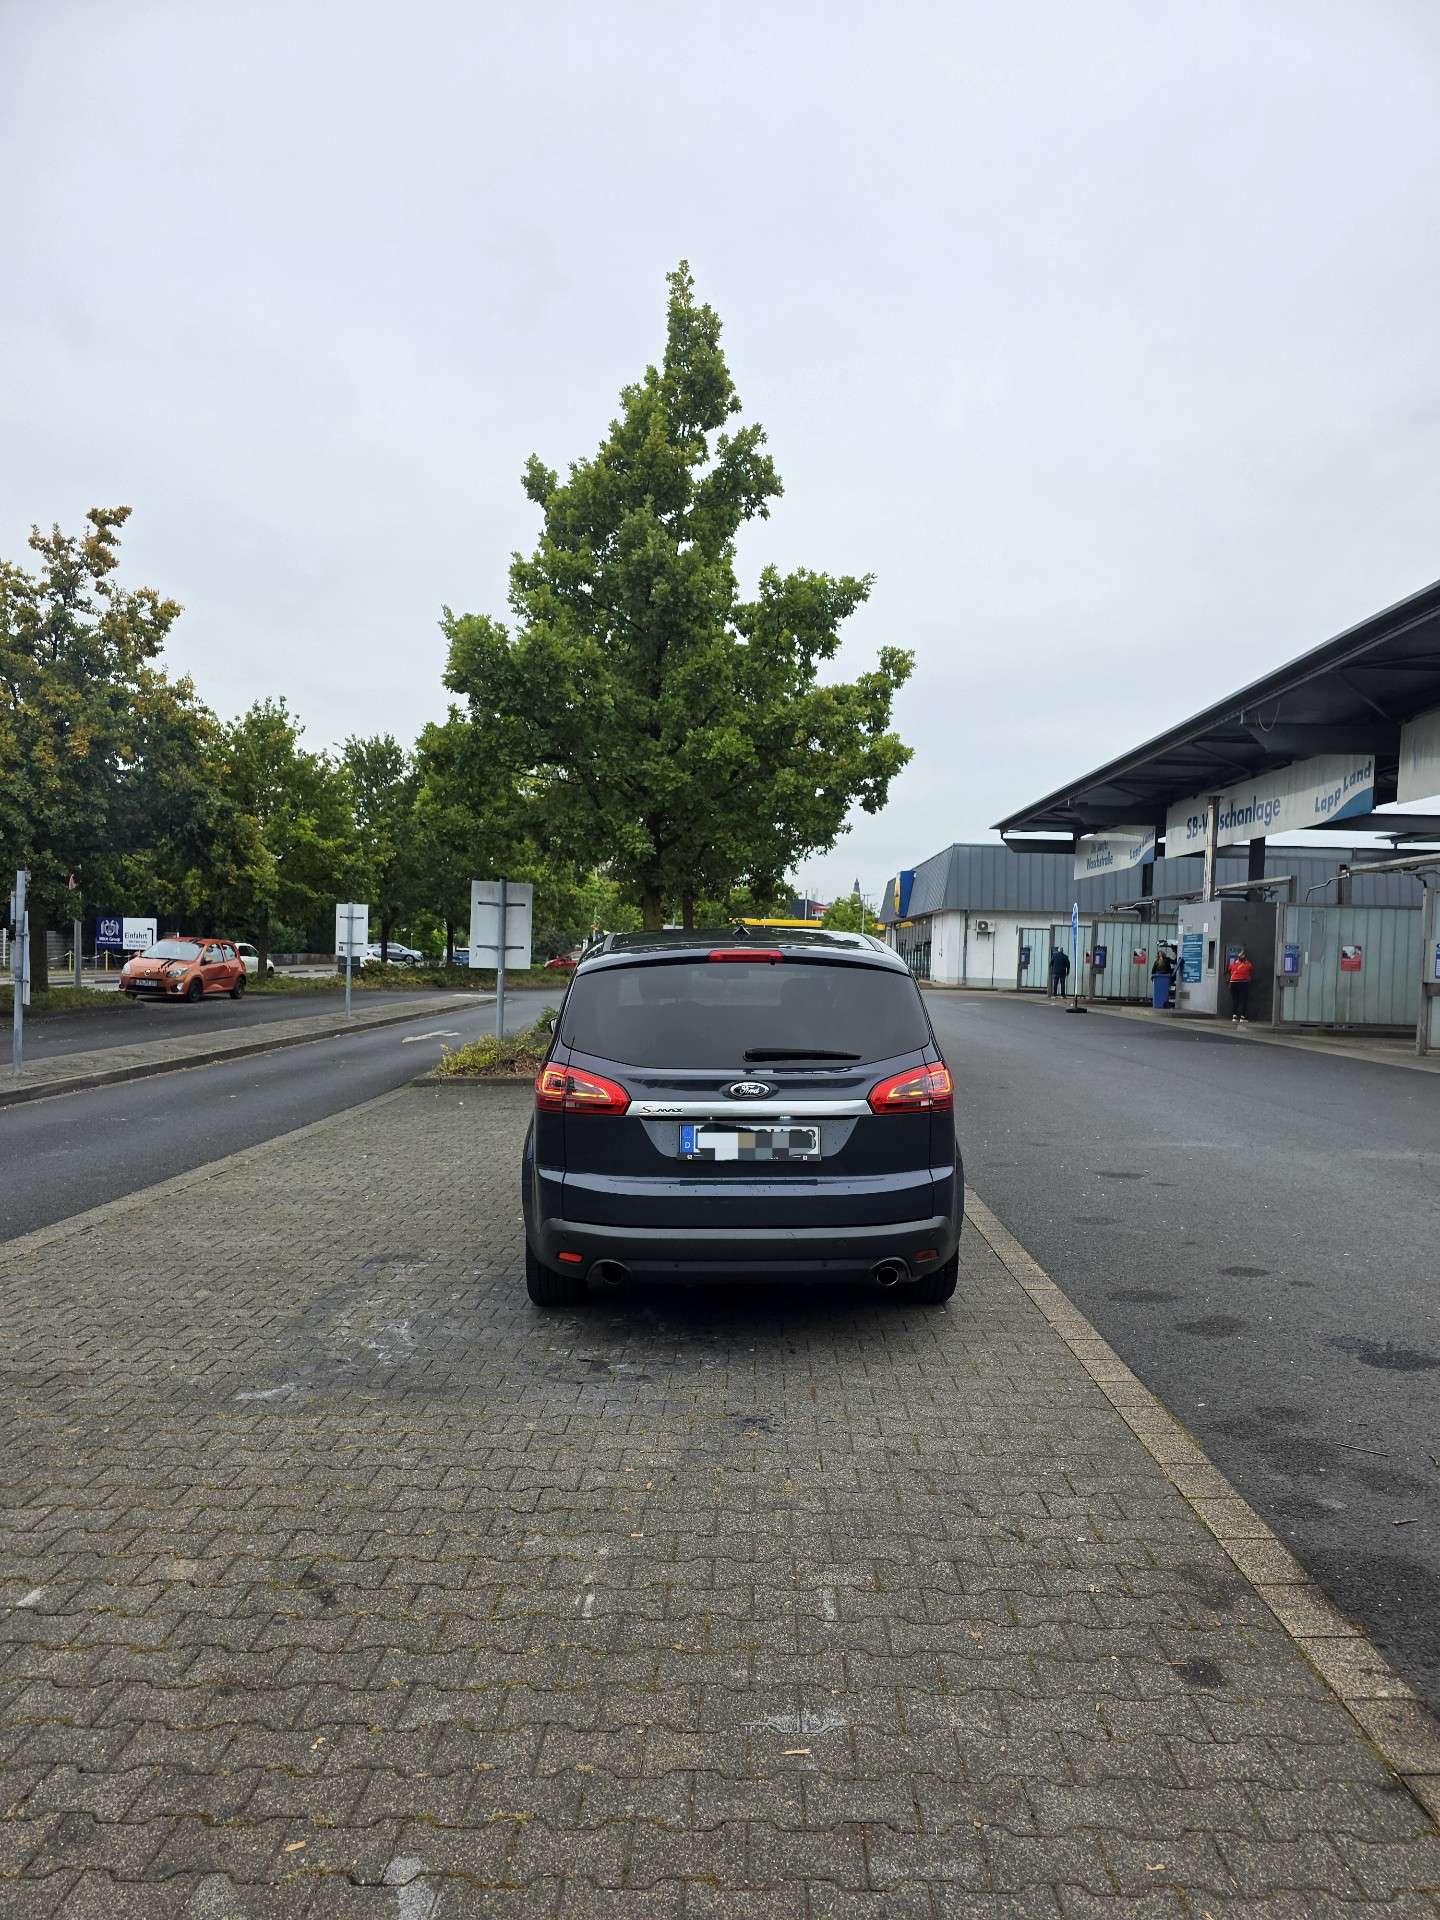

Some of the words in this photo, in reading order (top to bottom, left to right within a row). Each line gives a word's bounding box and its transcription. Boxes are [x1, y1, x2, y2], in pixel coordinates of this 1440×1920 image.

[1315, 787, 1341, 813] Lapp
[1343, 760, 1372, 793] Land
[124, 931, 148, 940] Einfahrt
[739, 1085, 761, 1096] Ford
